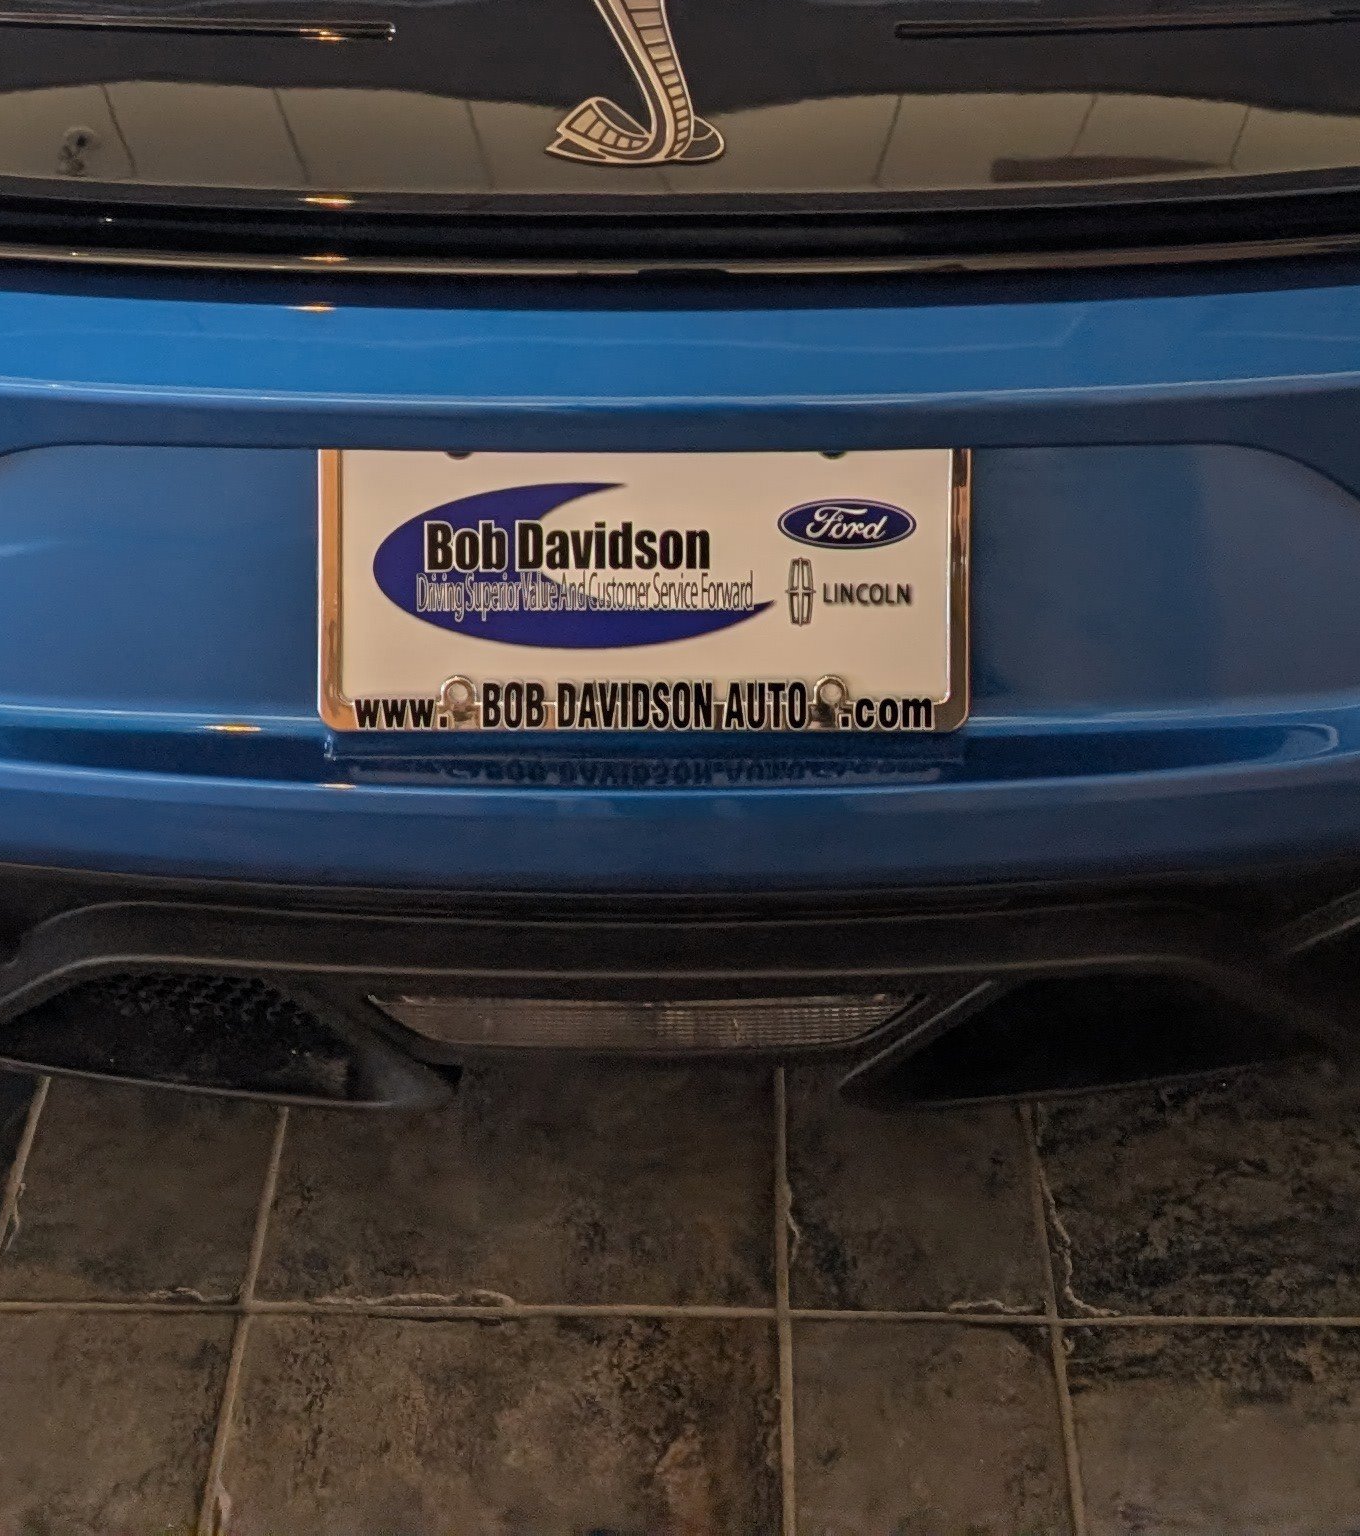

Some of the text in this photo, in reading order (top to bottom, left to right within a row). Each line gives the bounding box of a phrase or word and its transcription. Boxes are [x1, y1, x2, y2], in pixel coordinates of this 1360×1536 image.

[425, 520, 711, 572] Bob Davidson
[806, 506, 888, 540] Ford
[416, 569, 754, 622] Driving Superior Value And Customer Service Forward
[822, 582, 913, 605] LINCOLN
[354, 681, 933, 730] www. BOB DAVIDSON AUTO .com
